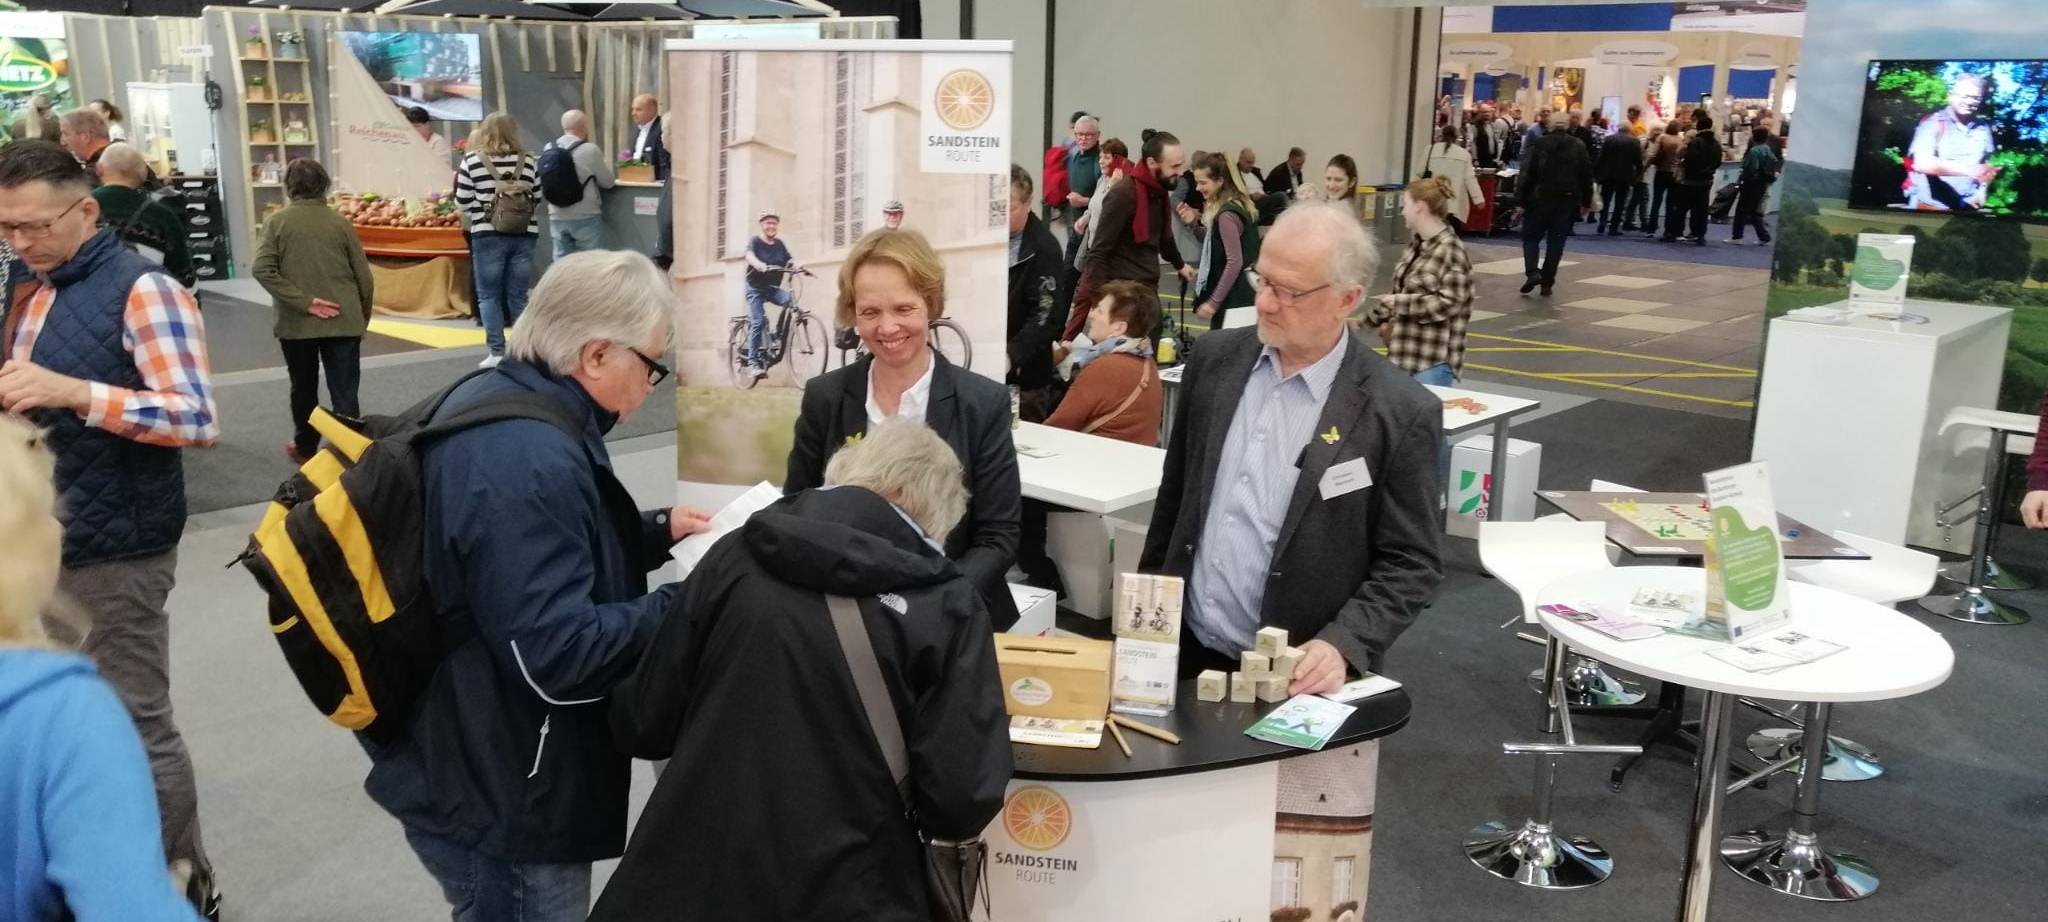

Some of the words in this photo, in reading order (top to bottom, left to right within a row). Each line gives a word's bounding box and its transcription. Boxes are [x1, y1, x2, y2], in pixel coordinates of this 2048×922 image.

[928, 135, 1000, 148] SANDSTEIN
[945, 150, 982, 162] ROUTE
[995, 851, 1077, 872] SANDSTEIN
[1015, 868, 1057, 885] ROUTE
